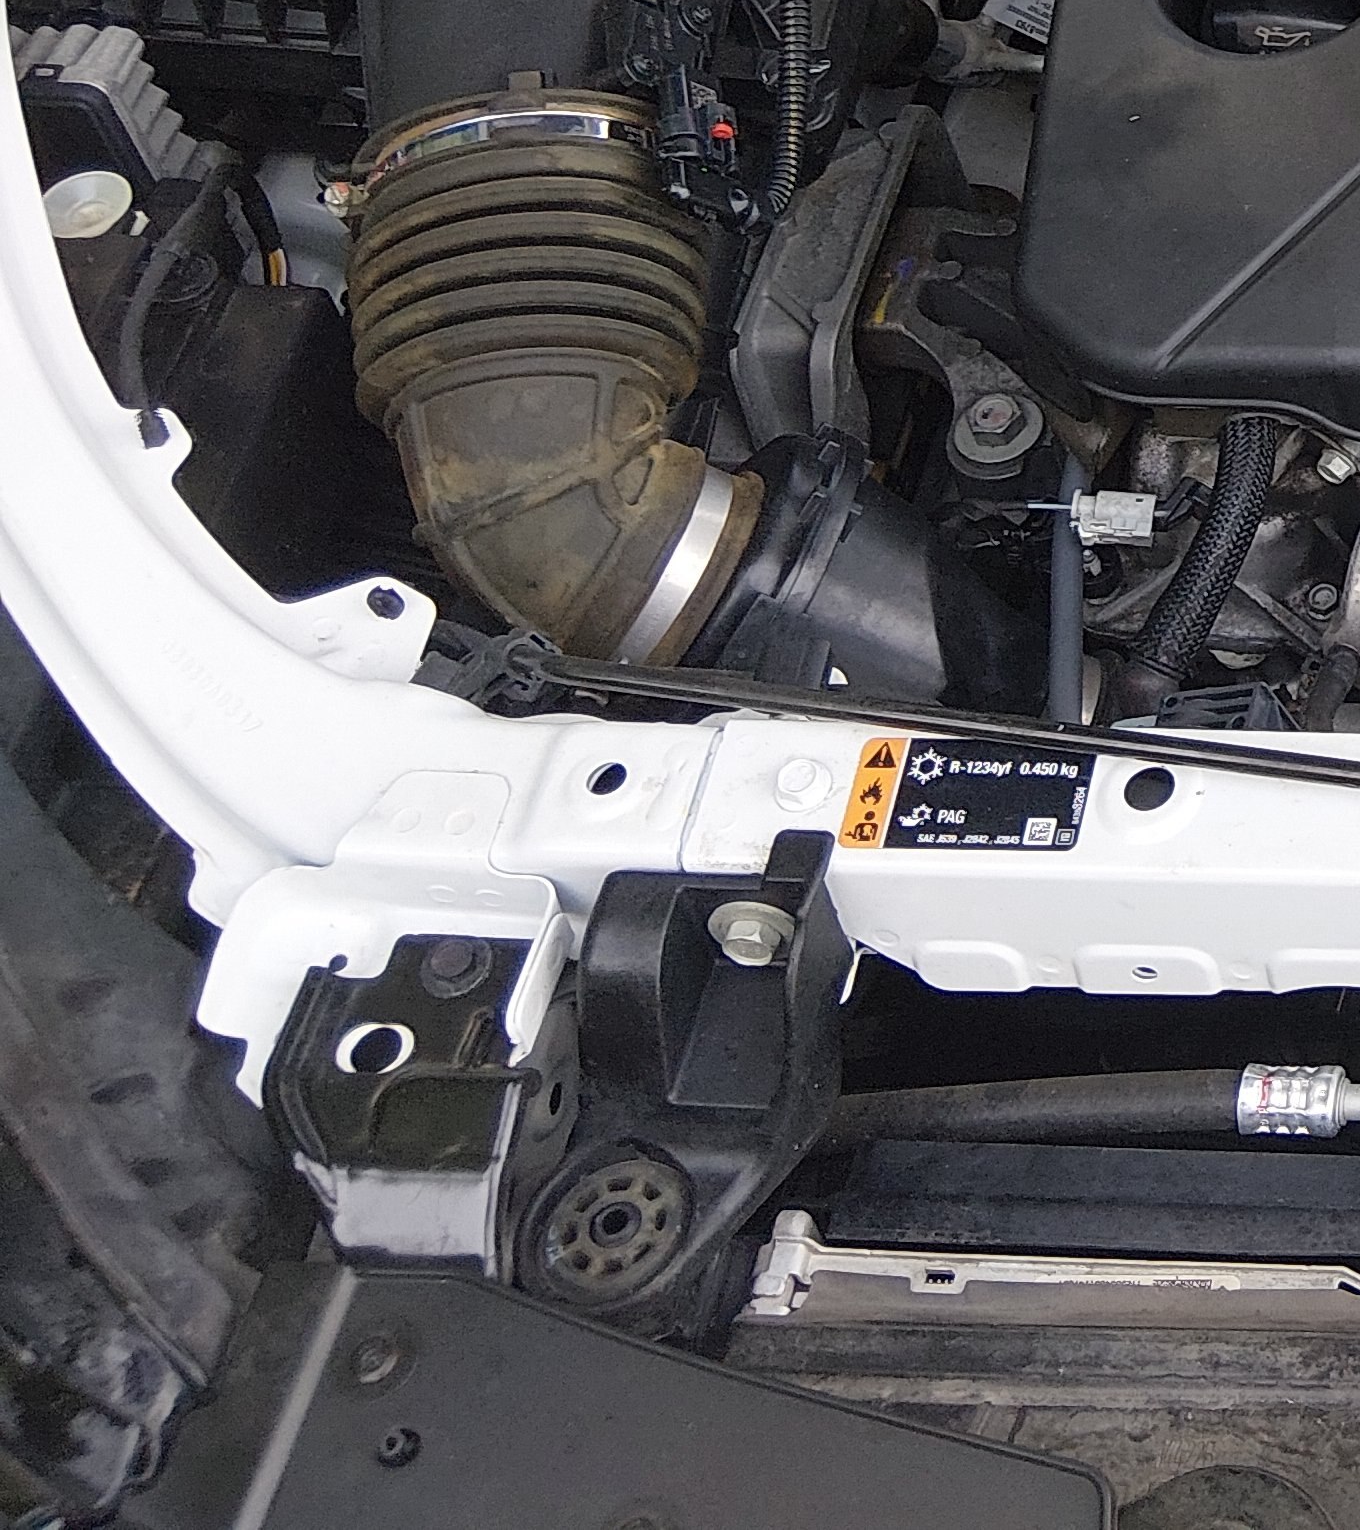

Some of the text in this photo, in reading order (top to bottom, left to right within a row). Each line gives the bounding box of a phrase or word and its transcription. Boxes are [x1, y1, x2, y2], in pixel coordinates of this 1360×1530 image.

[948, 760, 1079, 779] R-1234yf 0.450 kg
[936, 809, 968, 825] PAG
[916, 833, 935, 844] SAE
